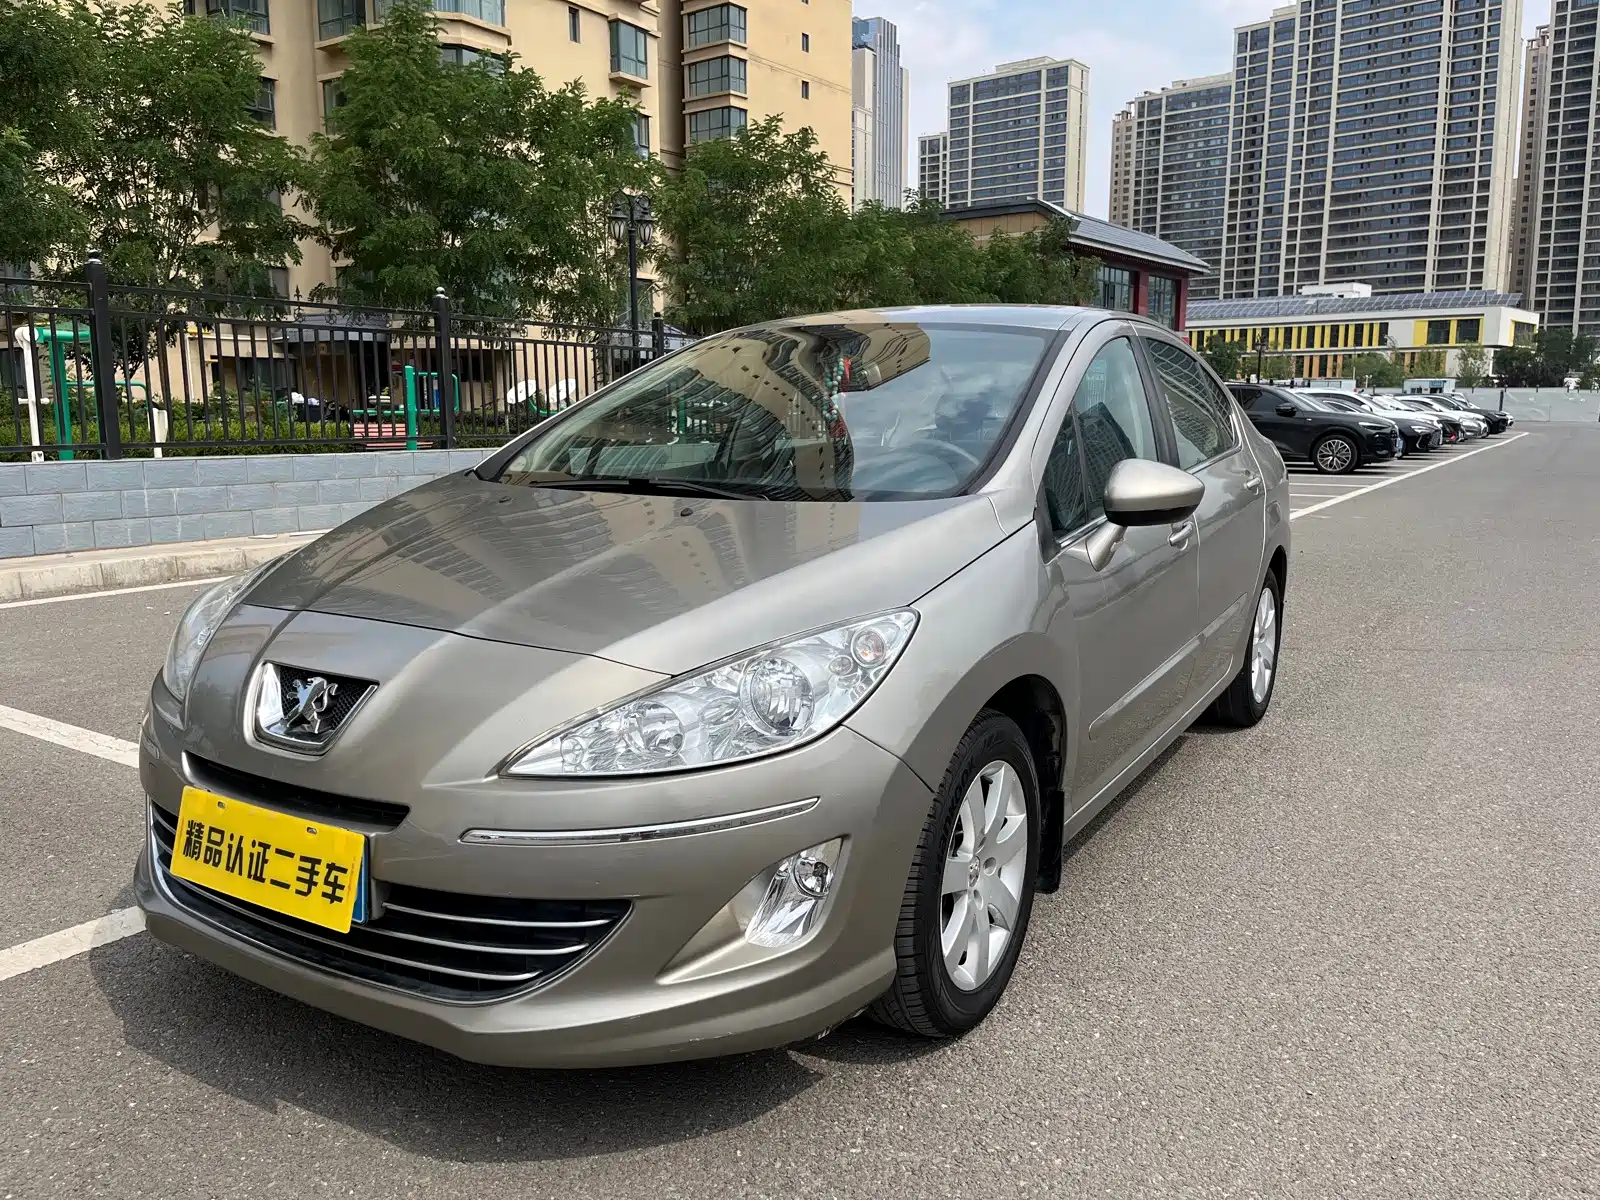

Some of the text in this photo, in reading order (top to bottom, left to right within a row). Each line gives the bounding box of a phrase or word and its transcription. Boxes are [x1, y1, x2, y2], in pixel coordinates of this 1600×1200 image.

[182, 819, 349, 905] 精品认证二手车
